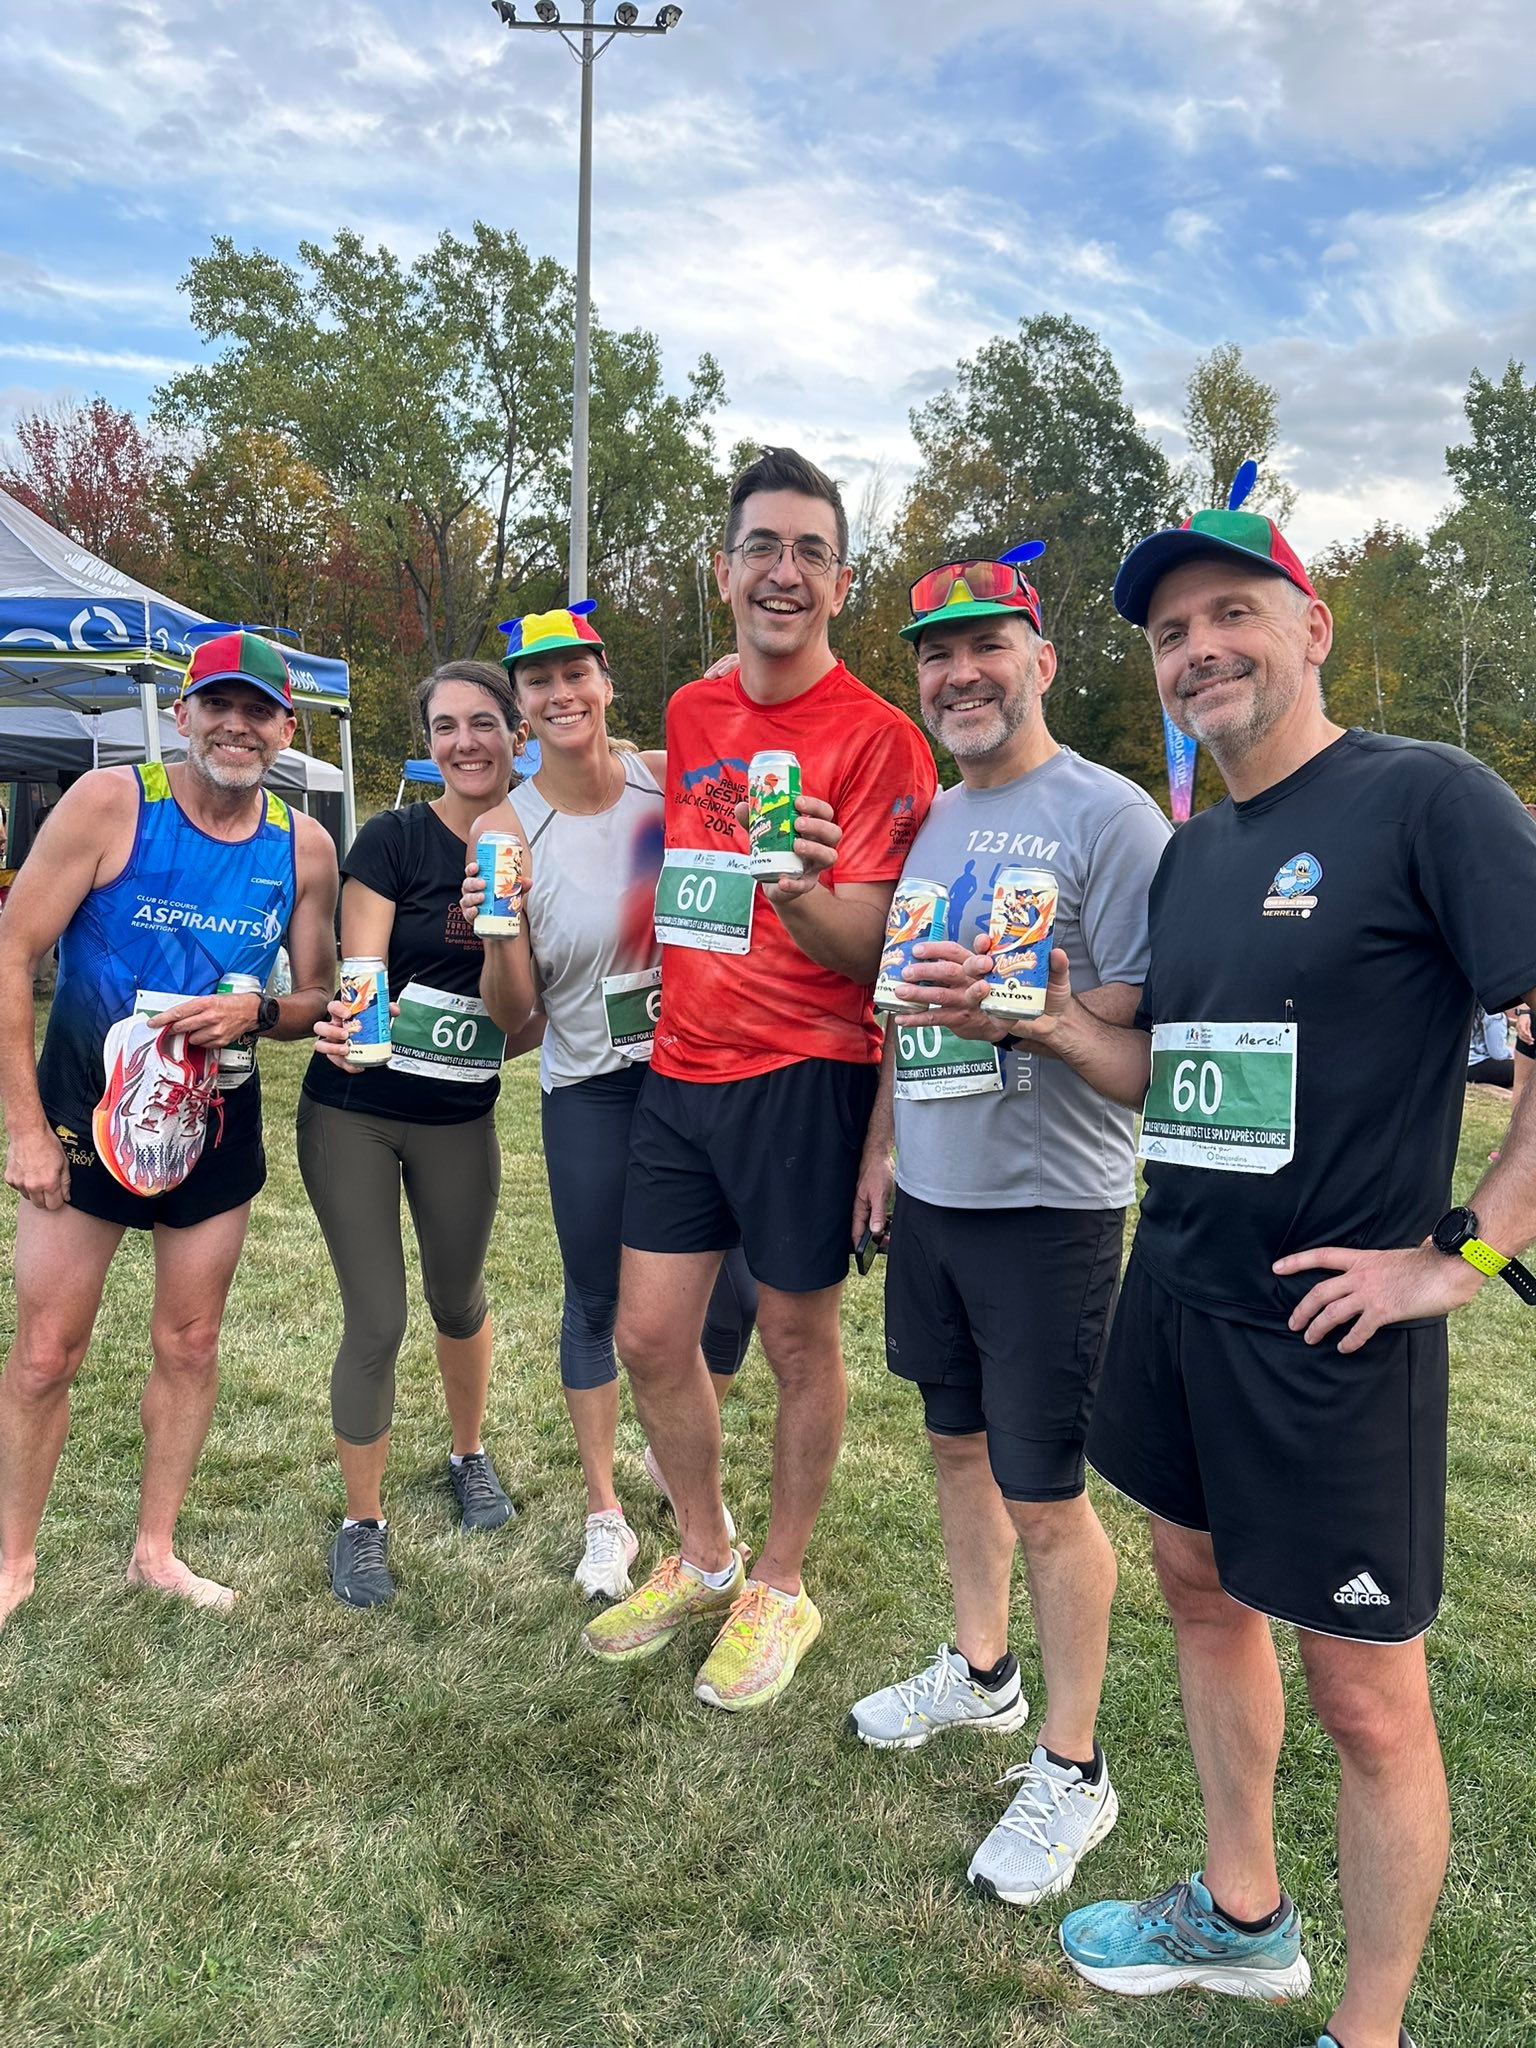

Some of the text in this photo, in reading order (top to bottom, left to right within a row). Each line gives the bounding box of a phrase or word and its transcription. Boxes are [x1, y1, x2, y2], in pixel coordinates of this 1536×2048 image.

[704, 815, 736, 838] 2025
[966, 829, 1061, 861] 123 KM
[136, 894, 198, 910] CLUB DE COURSE
[677, 874, 716, 912] 60
[131, 920, 179, 934] REPENTIGNY
[134, 904, 263, 937] ASPIRANTS
[728, 926, 746, 936] COURSE
[990, 991, 1032, 1000] CANTONS
[646, 990, 662, 1022] 6
[432, 1015, 478, 1052] 60
[622, 1036, 627, 1044] LE
[628, 1034, 637, 1043] FAIT
[637, 1033, 649, 1042] POUR
[897, 1026, 942, 1060] 60
[1235, 1032, 1282, 1046] Merci!
[396, 1045, 401, 1053] LE
[402, 1046, 412, 1056] FAIT
[412, 1049, 425, 1059] POUR
[425, 1052, 433, 1060] LES
[433, 1054, 452, 1063] ENFANTS
[924, 1068, 931, 1077] ET
[931, 1068, 937, 1077] LE
[937, 1066, 947, 1076] SPA
[947, 1064, 970, 1075] D'APRÈS
[970, 1062, 994, 1073] COURSE
[1018, 1066, 1032, 1091] DU
[1172, 1060, 1223, 1116] 60
[1177, 1124, 1197, 1138] ENFANTS
[1198, 1127, 1204, 1138] ET
[1204, 1128, 1211, 1139] LE
[1212, 1129, 1223, 1140] SPA
[1224, 1129, 1254, 1142] D'APRÈS
[1255, 1132, 1286, 1145] COURSE
[1216, 1154, 1247, 1162] Desjardins
[1333, 1592, 1391, 1606] adidas
